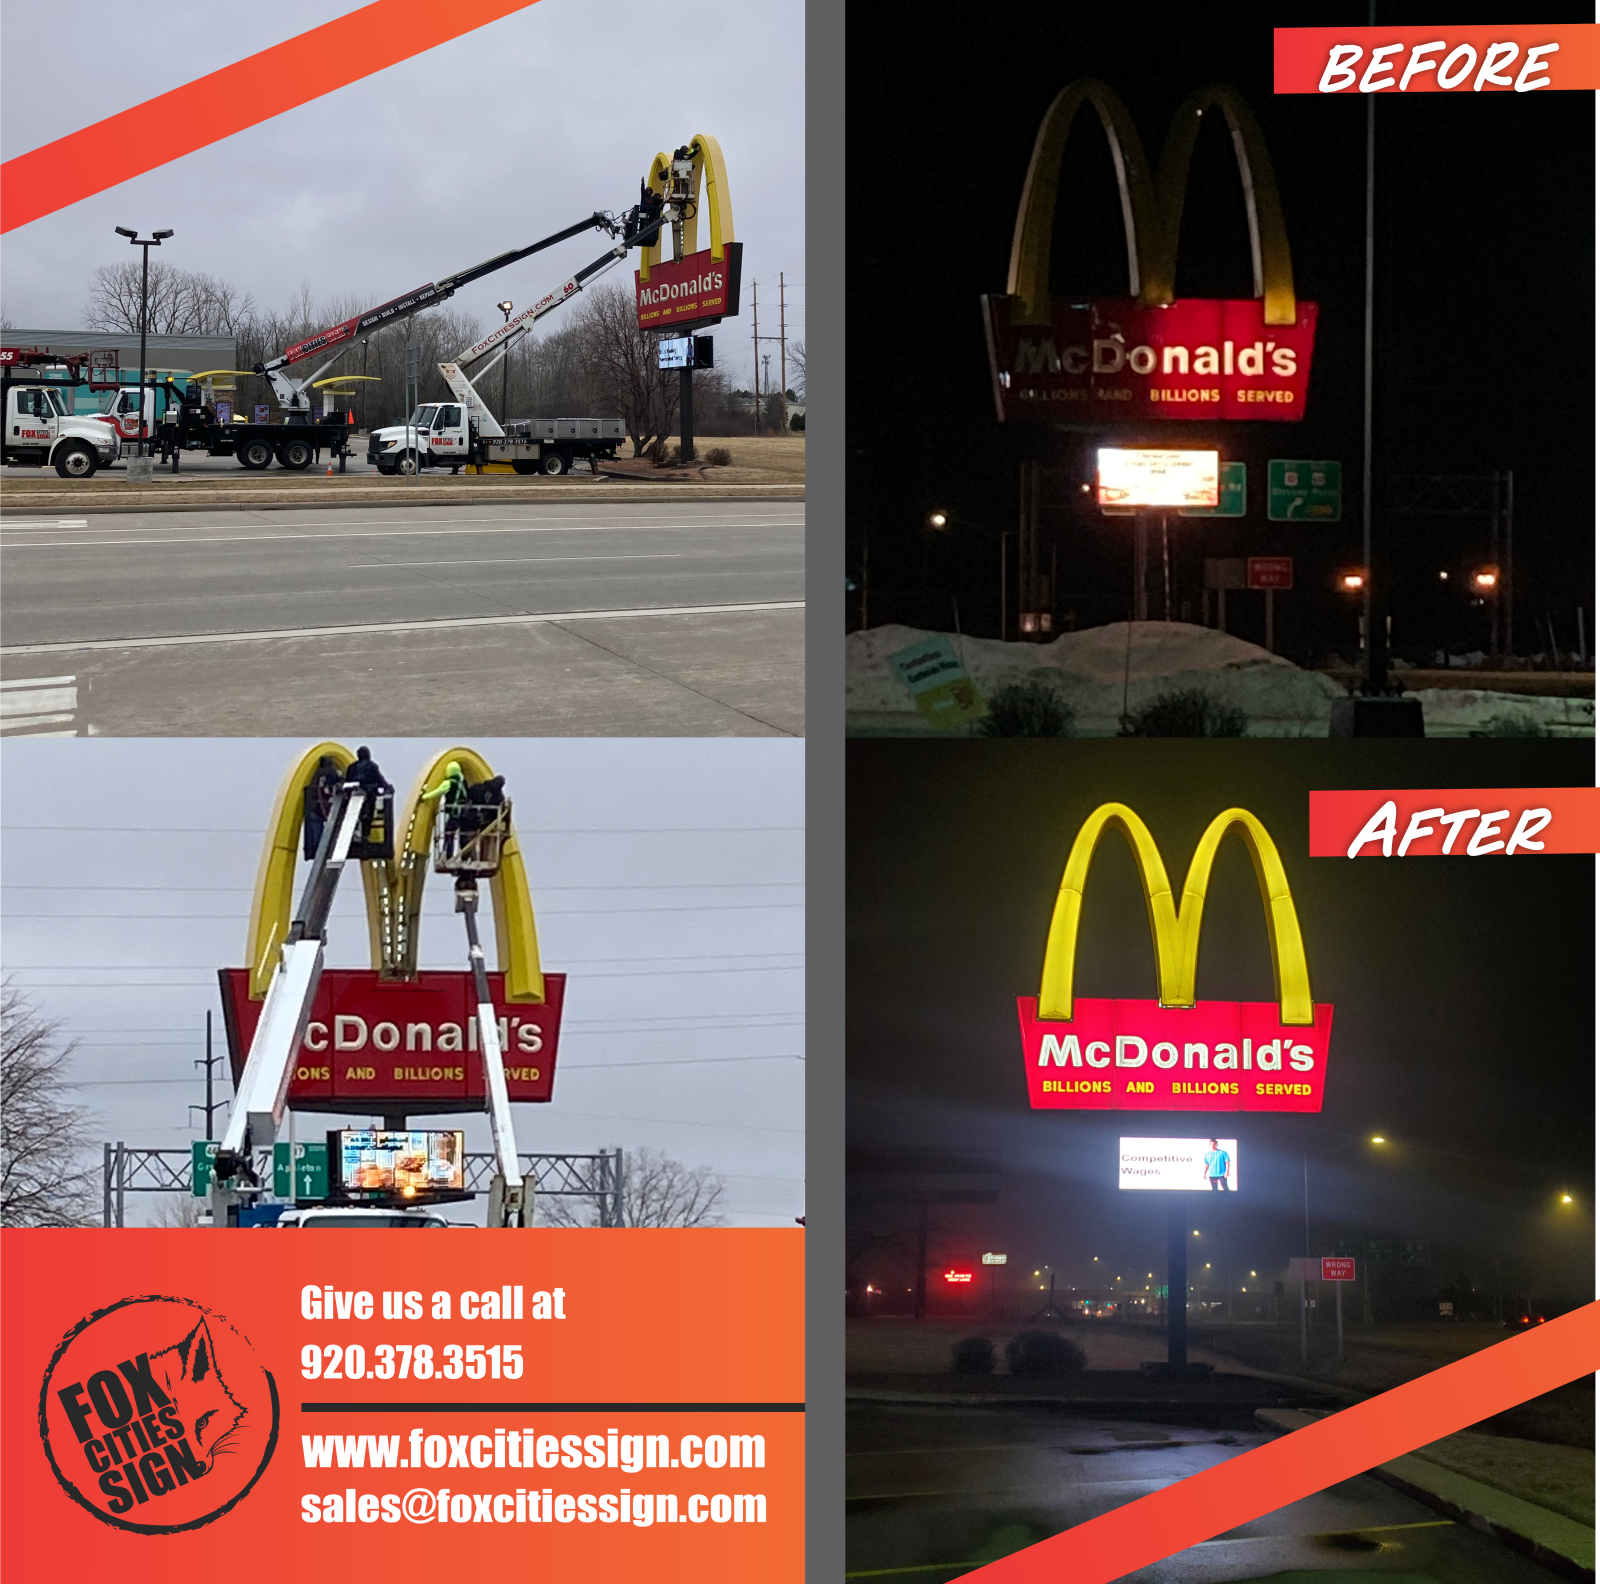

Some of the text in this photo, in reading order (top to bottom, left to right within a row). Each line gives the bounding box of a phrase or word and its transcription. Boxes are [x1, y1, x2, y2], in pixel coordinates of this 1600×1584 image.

[563, 283, 574, 293] 60
[640, 271, 723, 307] McDonald's
[398, 298, 416, 310] INSTALL
[419, 289, 436, 300] REPAIR
[640, 311, 660, 321] BILLIONS
[676, 303, 698, 313] BILLIONS
[702, 298, 722, 308] SERVED
[0, 351, 14, 361] 55
[1014, 337, 1298, 377] McDonald's
[1150, 389, 1221, 403] BILLIONS
[1237, 390, 1295, 403] SERVED
[22, 430, 36, 438] FOX
[1038, 1034, 1315, 1072] McDonald's
[346, 1068, 375, 1080] AND
[394, 1068, 464, 1080] BILLIONS
[1042, 1081, 1312, 1096] BILLIONS AND BILLIONS SERVED
[1121, 1154, 1193, 1164] Competitive
[1121, 1167, 1161, 1177] Wages
[1326, 1261, 1351, 1269] WRONG
